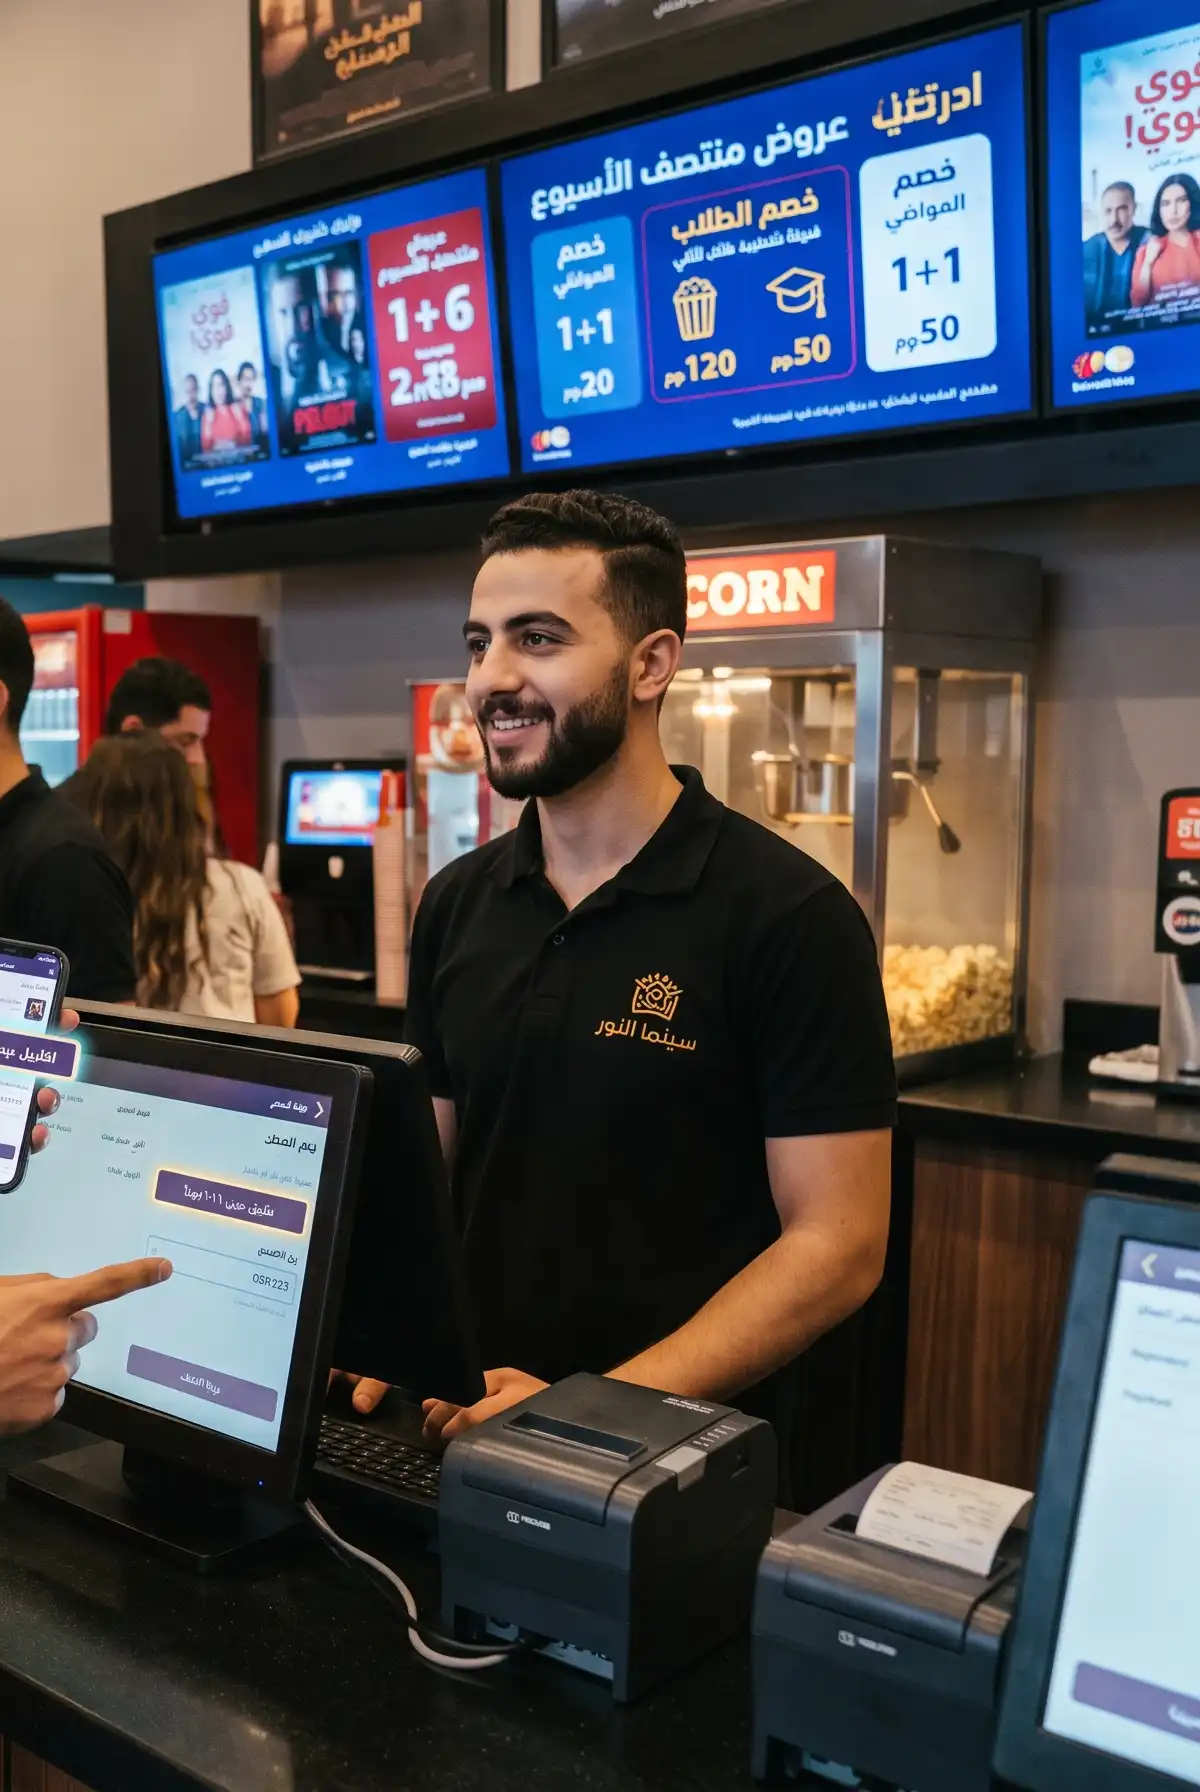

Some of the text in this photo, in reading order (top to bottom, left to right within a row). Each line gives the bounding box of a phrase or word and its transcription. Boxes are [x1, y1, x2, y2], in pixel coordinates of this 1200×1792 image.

[1134, 60, 1200, 115] وي
[753, 115, 849, 167] عروض
[1124, 106, 1200, 155] وي!
[640, 138, 746, 186] منتصف
[893, 157, 956, 199] خصم
[530, 157, 633, 221] الأسبوع
[758, 187, 820, 231] خصم
[556, 233, 606, 272] خصم
[687, 564, 825, 619] CORN
[594, 1018, 697, 1052] سينما النور
